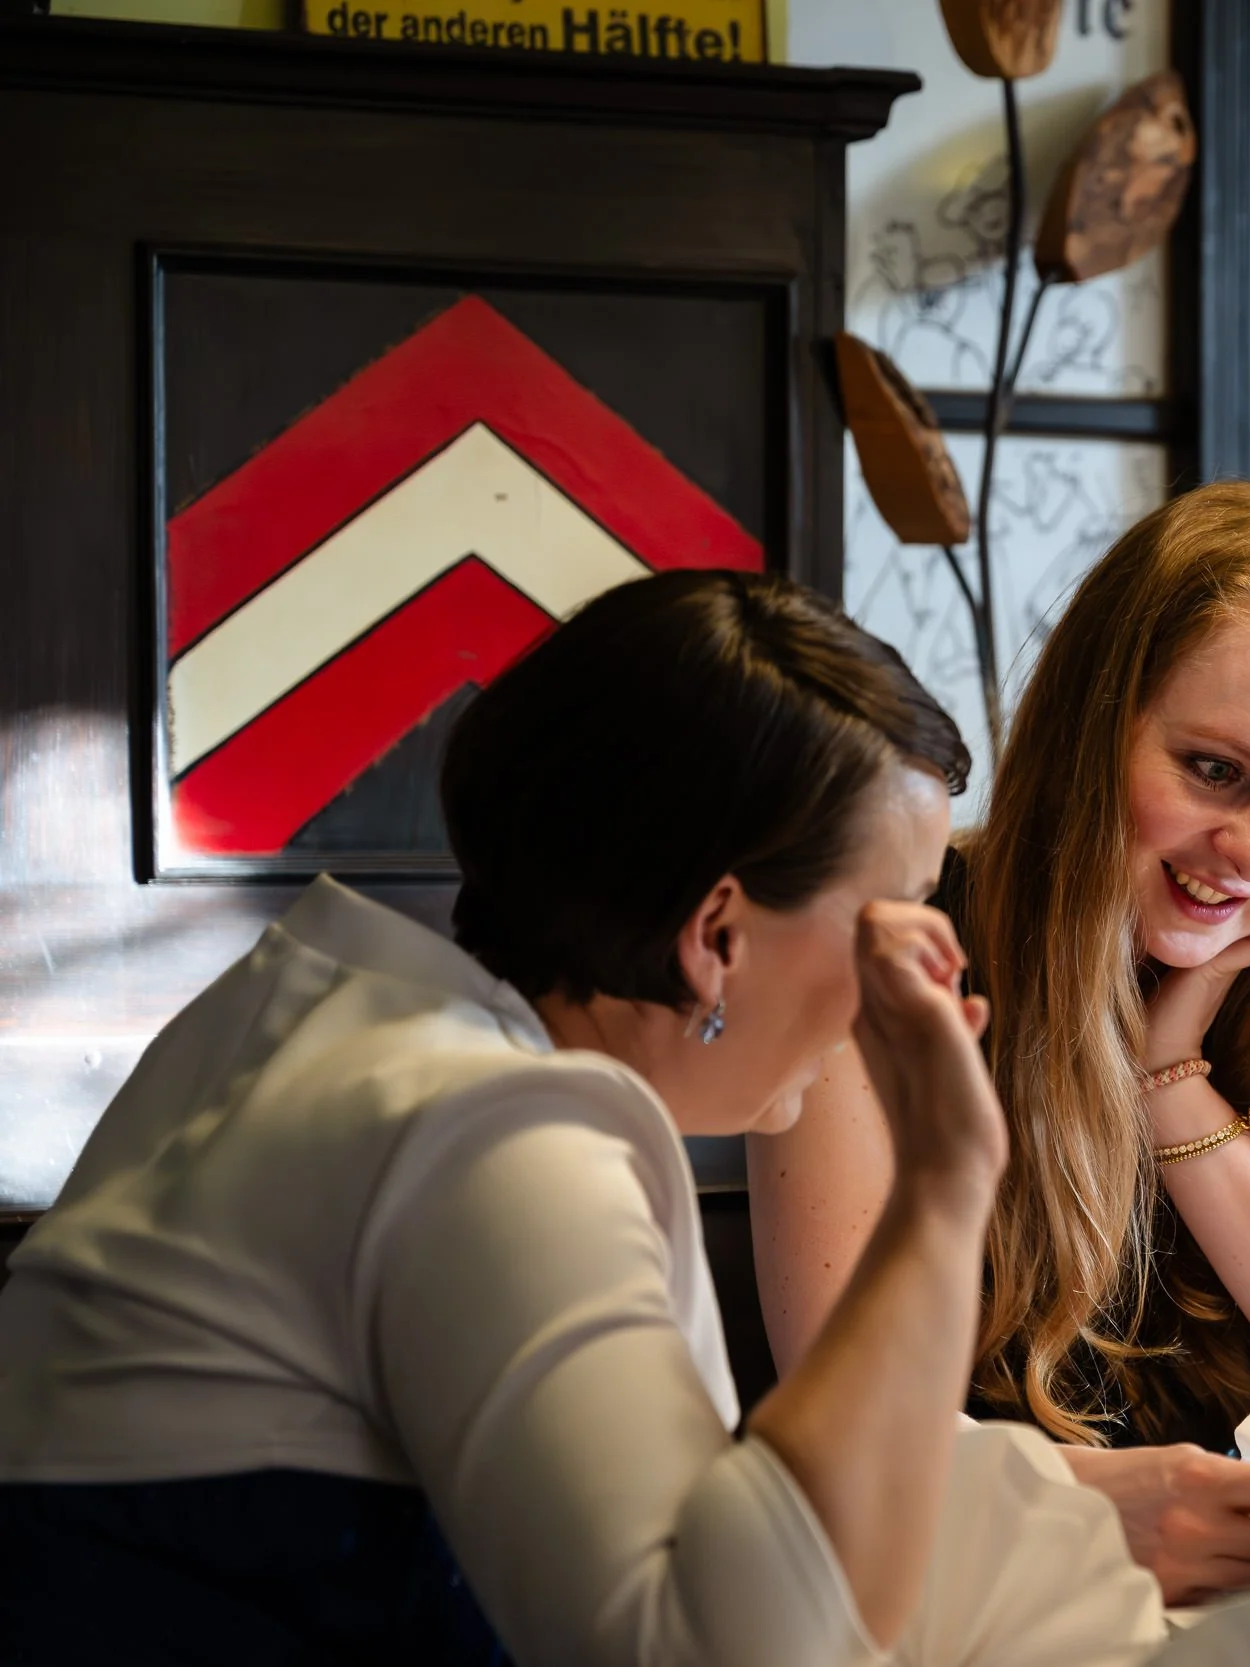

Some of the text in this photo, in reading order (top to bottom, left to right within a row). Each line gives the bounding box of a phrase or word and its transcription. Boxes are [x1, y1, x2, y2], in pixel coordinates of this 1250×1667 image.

[327, 3, 742, 62] der anderen Hälfte!
